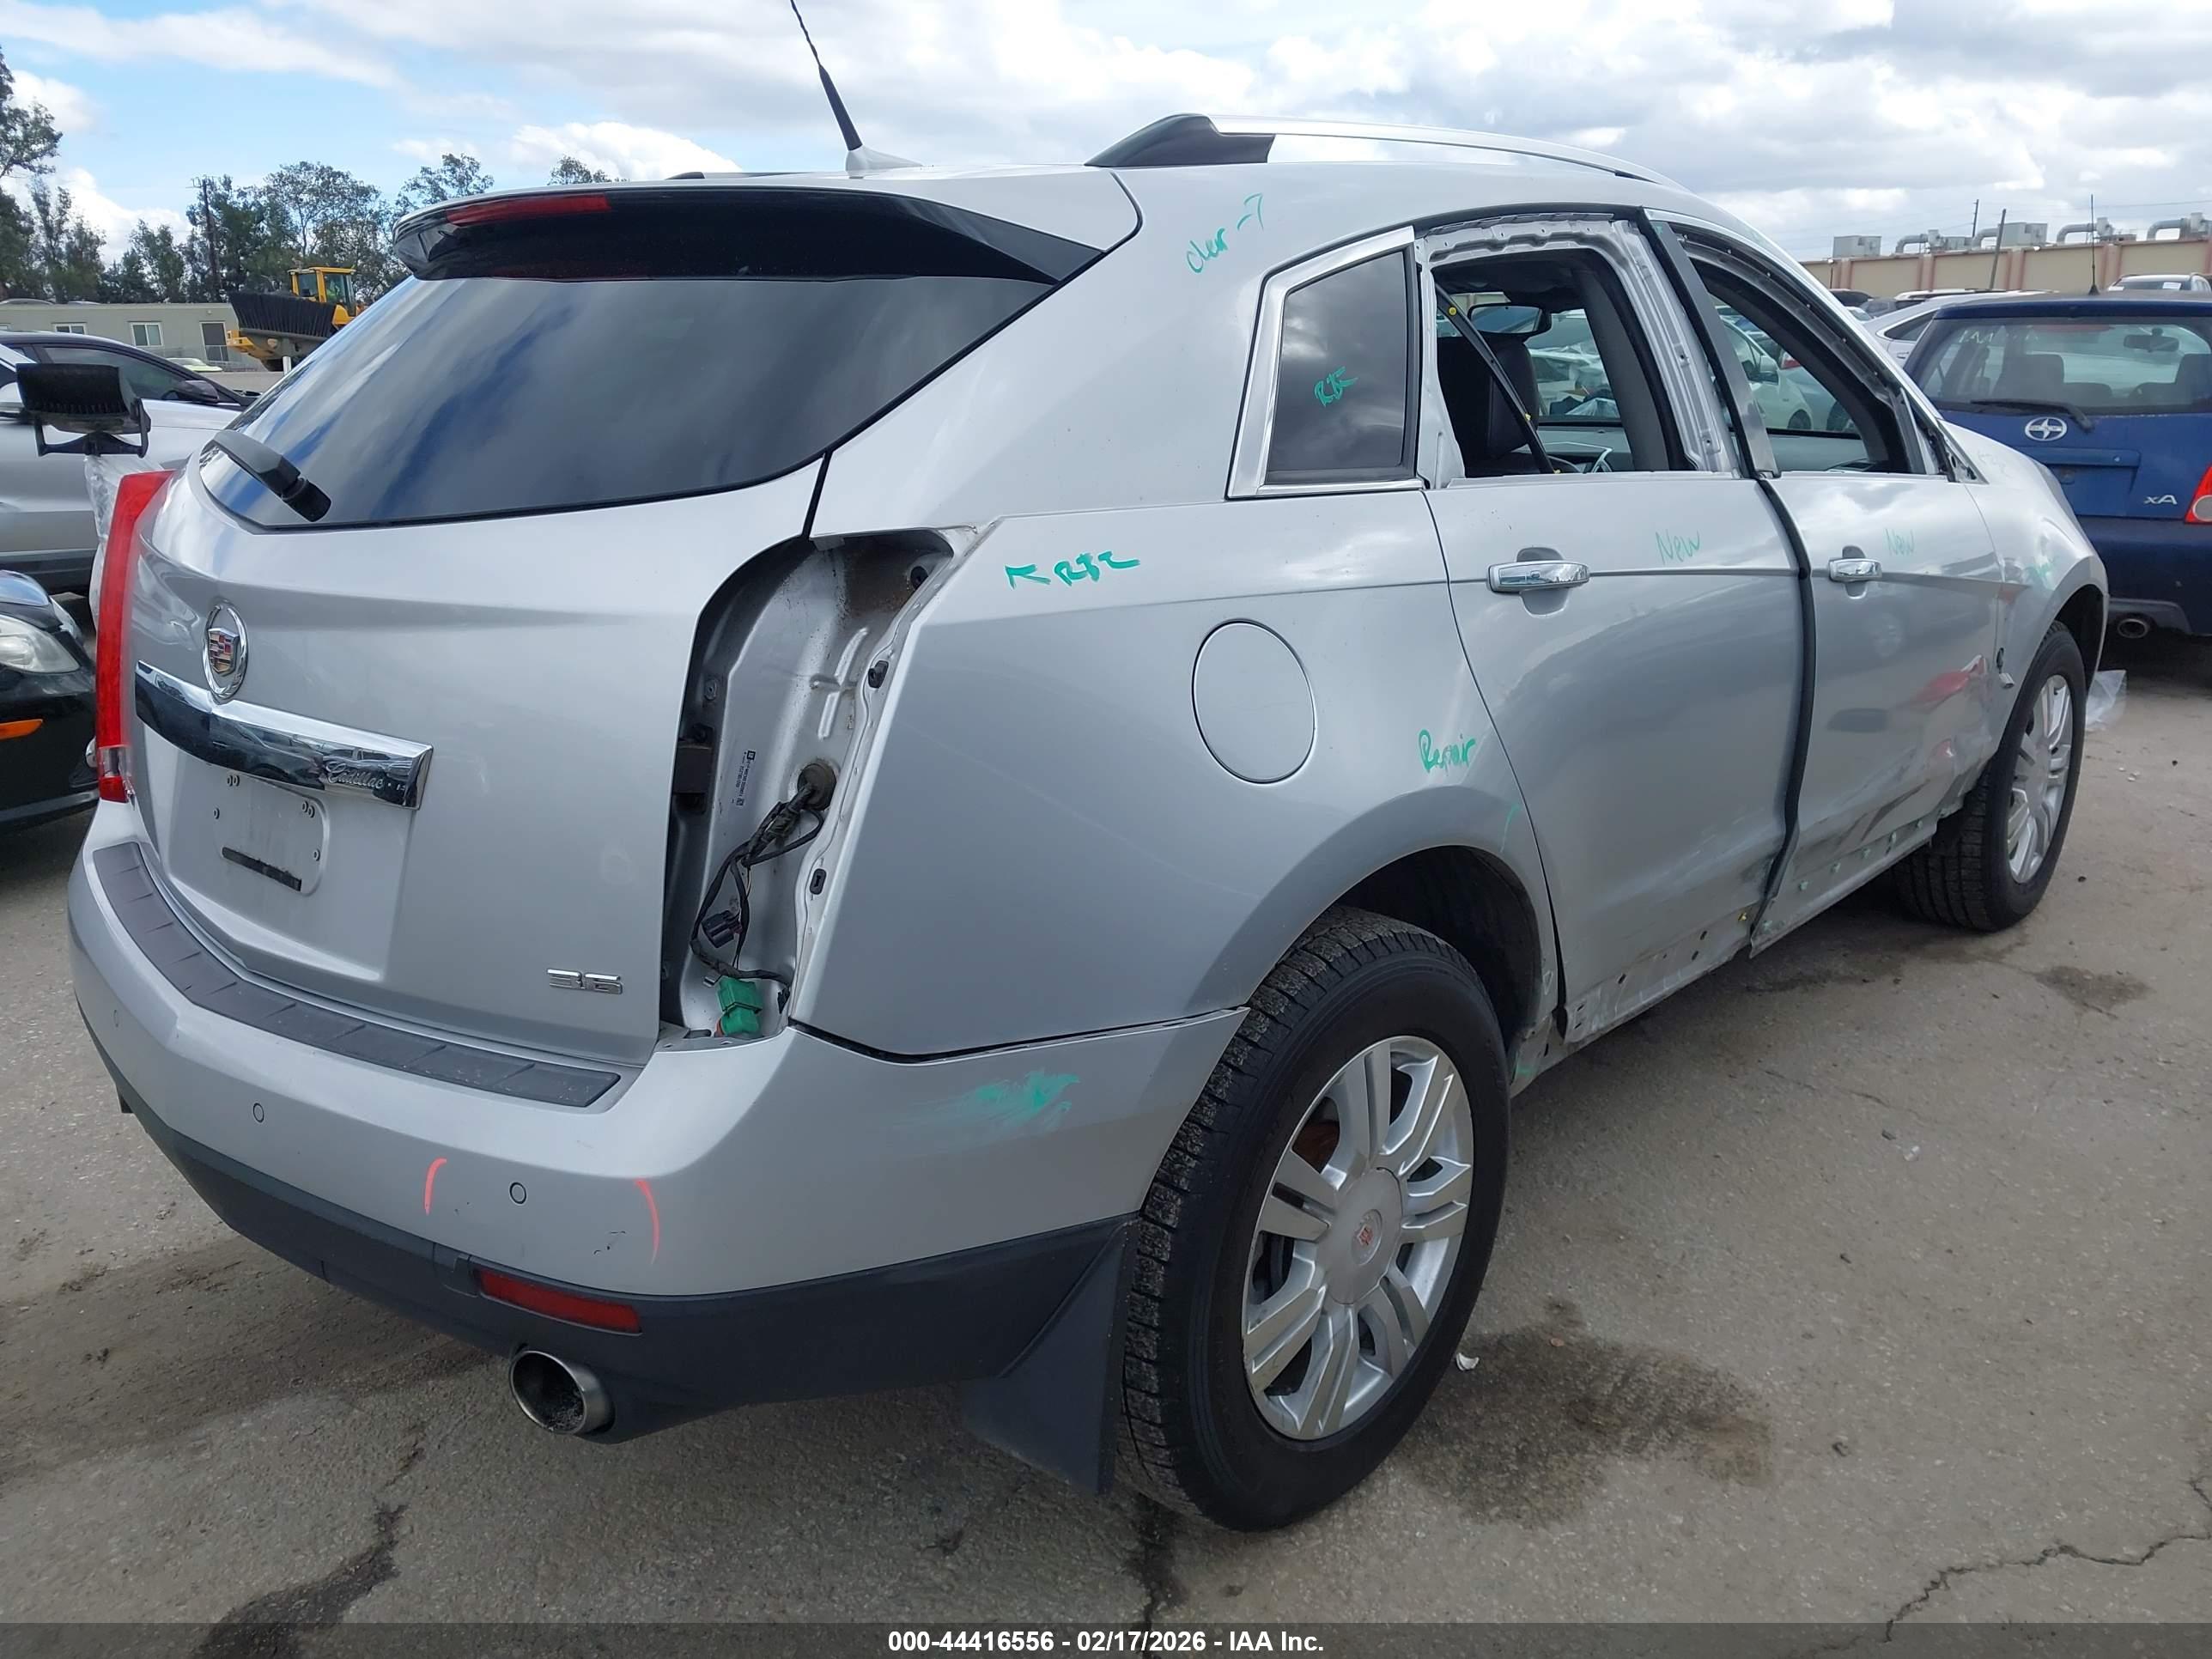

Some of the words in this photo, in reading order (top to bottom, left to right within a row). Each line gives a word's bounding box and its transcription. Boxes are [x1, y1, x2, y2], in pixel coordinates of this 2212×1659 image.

[2143, 495, 2178, 505] xA
[1655, 529, 1701, 566] New
[325, 761, 384, 789] Cadillac
